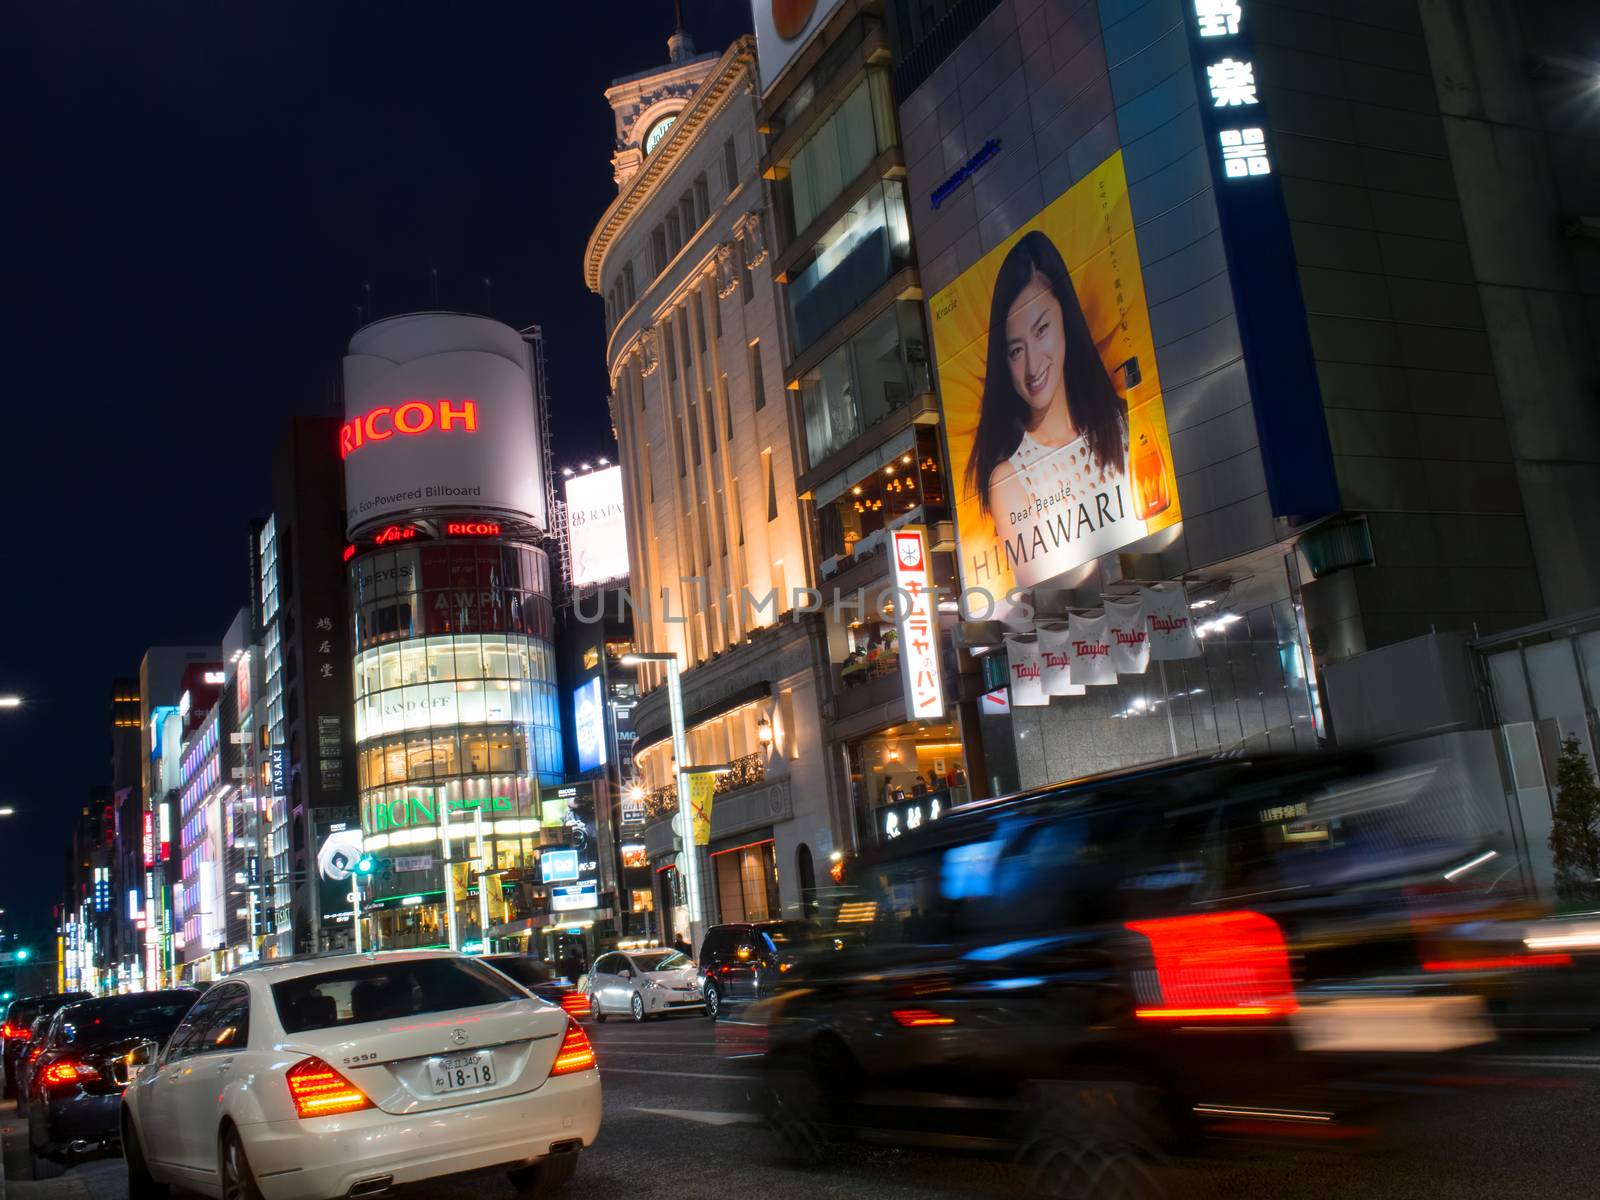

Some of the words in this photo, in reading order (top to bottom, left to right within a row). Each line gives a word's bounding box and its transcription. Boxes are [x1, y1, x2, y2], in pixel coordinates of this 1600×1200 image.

[340, 400, 478, 460] RICOH
[359, 488, 422, 513] Eco-Powered
[425, 485, 481, 497] Billboard
[1009, 504, 1032, 526] Dear
[1035, 480, 1072, 513] Beauté
[448, 523, 500, 535] RICOH
[972, 484, 1125, 585] HIMAWARI
[1147, 615, 1189, 632] Taylor
[1041, 651, 1070, 670] Tayl
[1072, 640, 1110, 660] Taylor
[273, 749, 283, 792] TASAKI
[448, 1064, 492, 1089] 18-18
